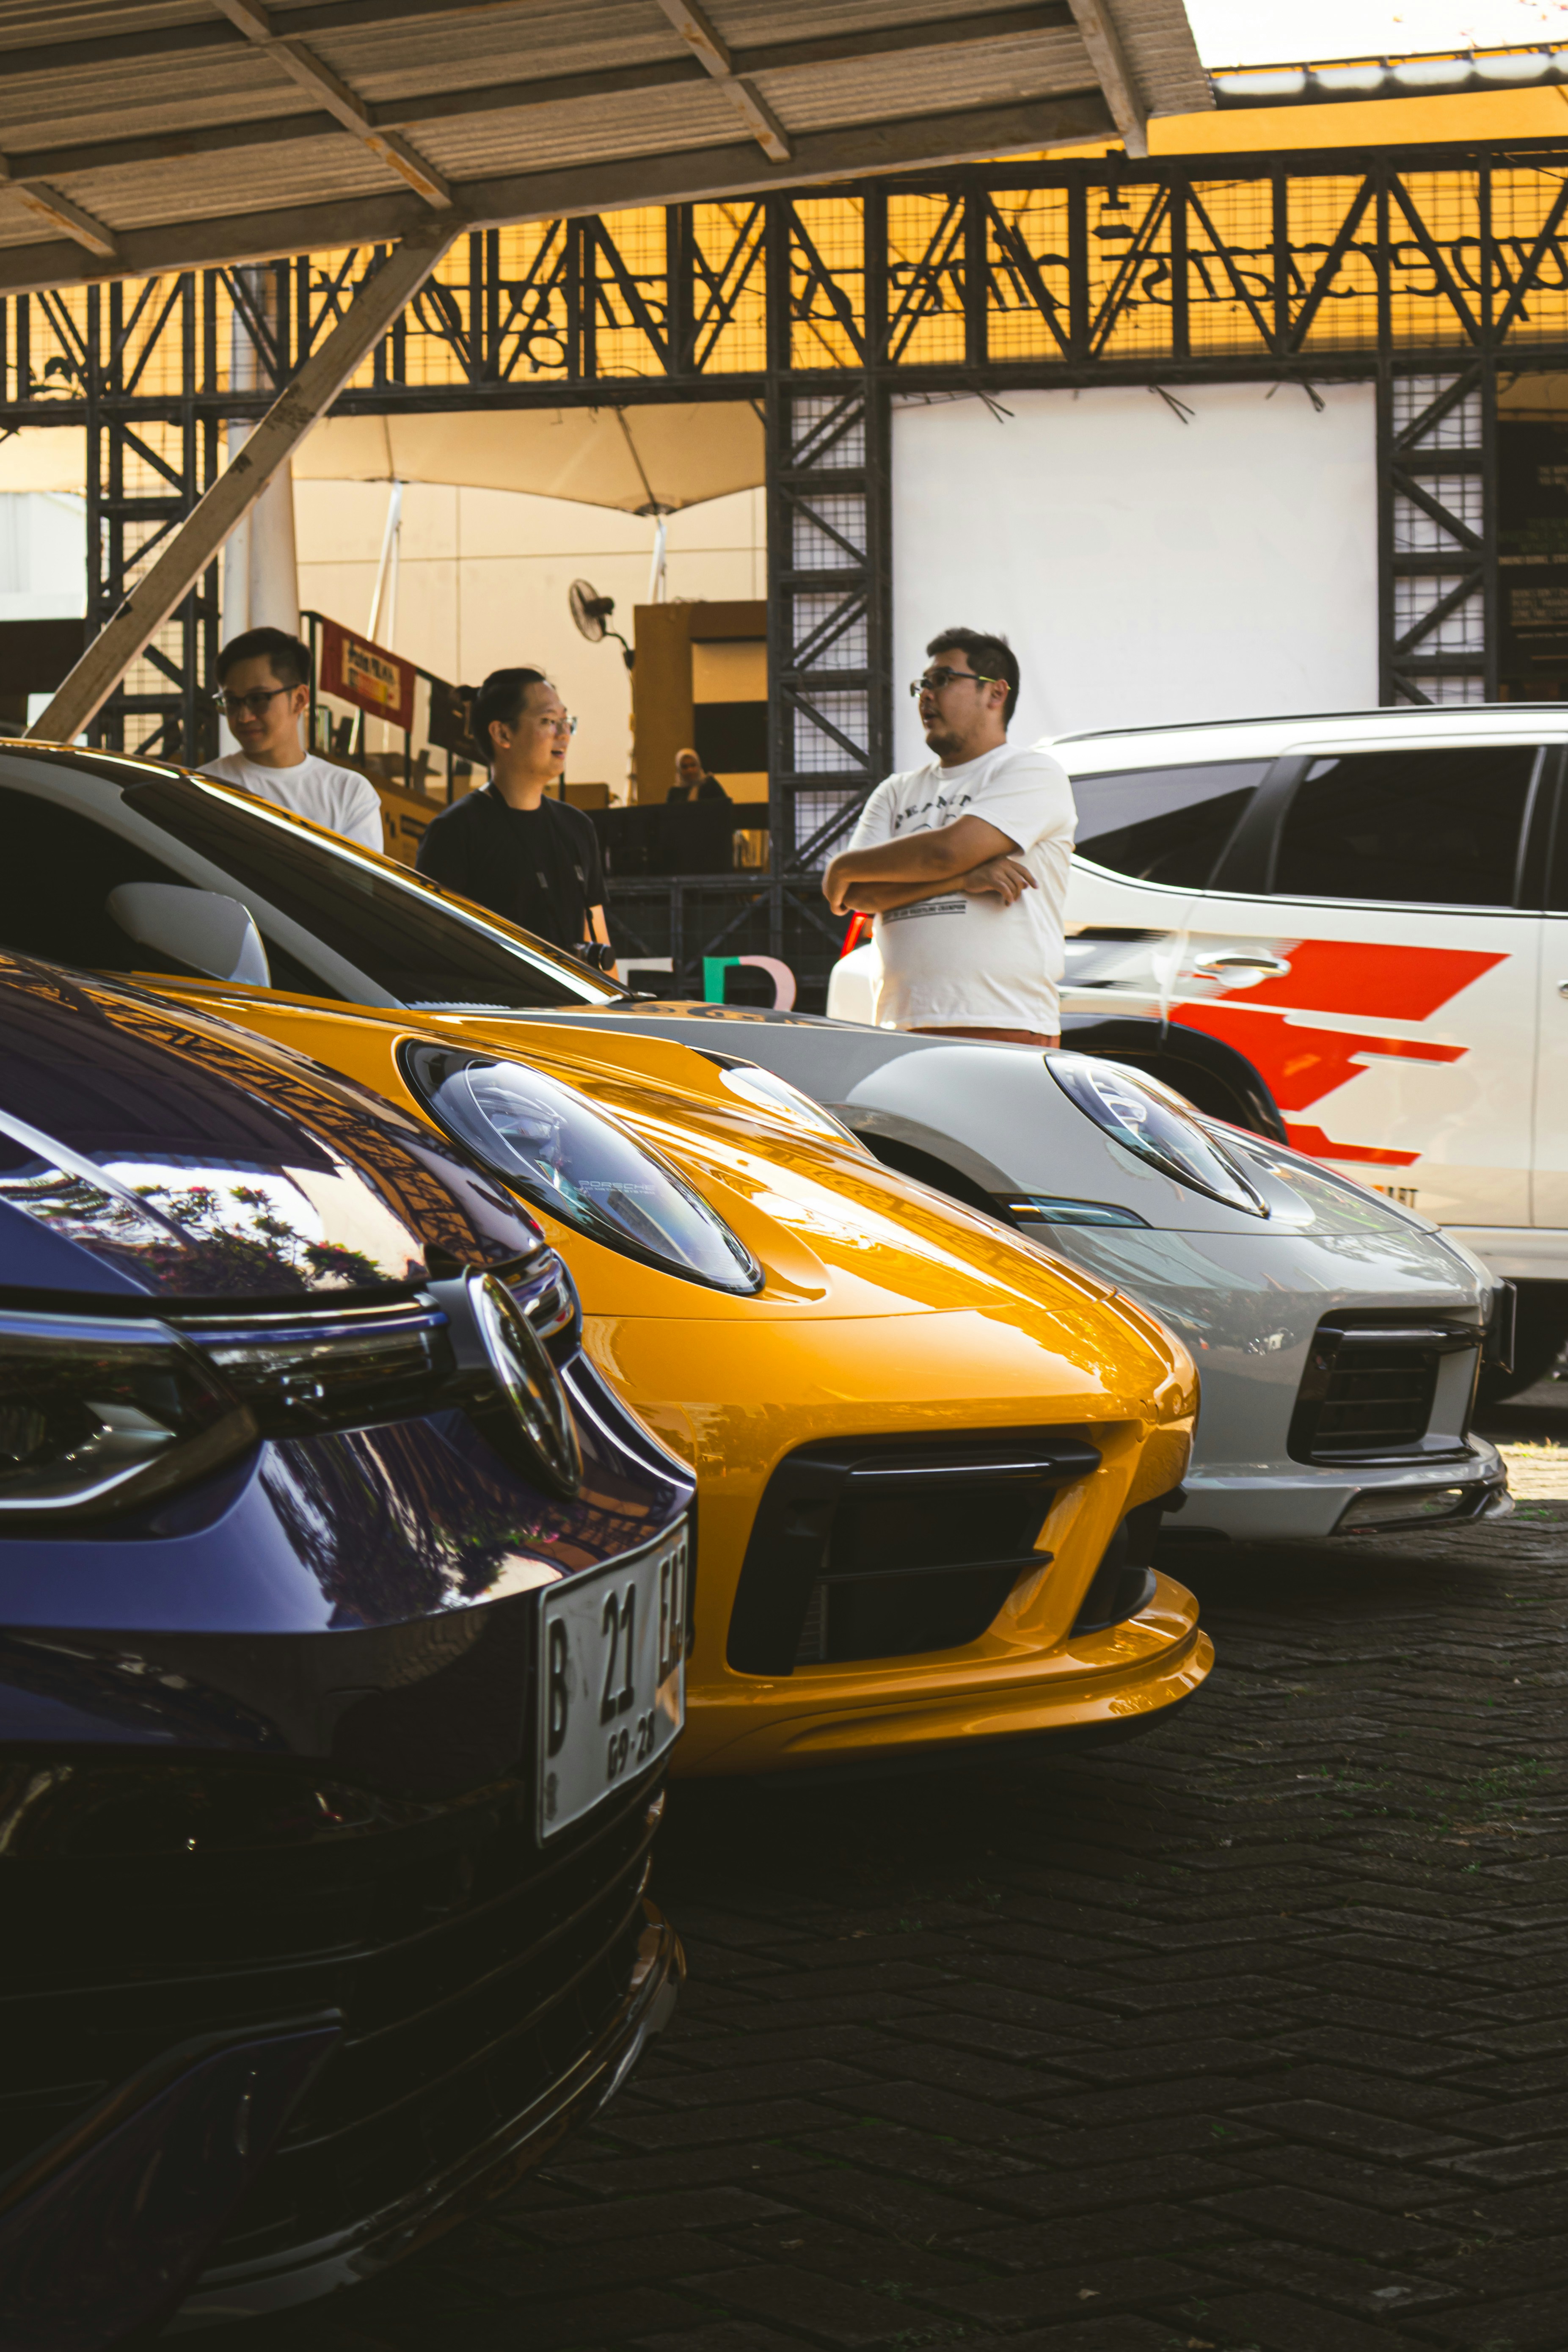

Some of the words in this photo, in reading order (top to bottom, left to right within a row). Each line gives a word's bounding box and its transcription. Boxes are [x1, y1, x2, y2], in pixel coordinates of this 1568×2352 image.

[578, 1180, 656, 1191] PORSCHE
[547, 1617, 568, 1758] B
[600, 1581, 636, 1727] 21
